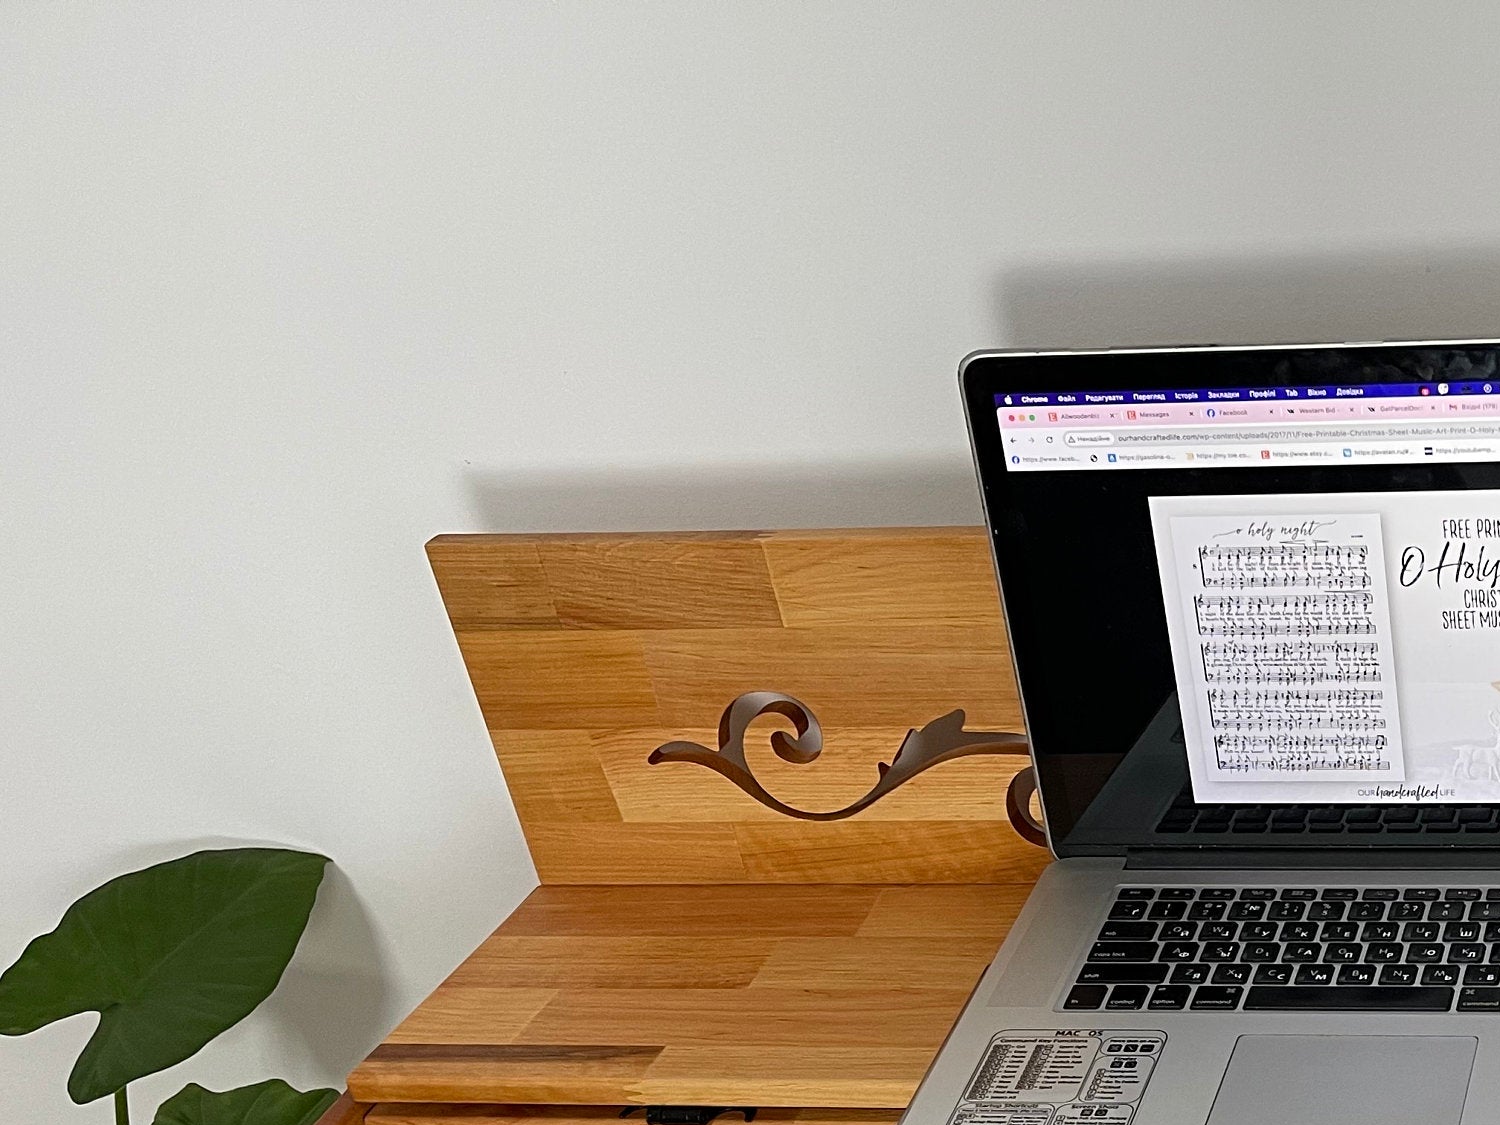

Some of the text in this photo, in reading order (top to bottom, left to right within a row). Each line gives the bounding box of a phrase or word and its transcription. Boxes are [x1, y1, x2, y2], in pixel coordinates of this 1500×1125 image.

[1085, 394, 1123, 403] Редагувати
[1133, 393, 1166, 402] Перегляд
[1175, 392, 1198, 400] Історія
[1208, 391, 1239, 399] Закладки
[1249, 390, 1275, 399] Профілі
[1286, 389, 1298, 397] Tab
[1336, 388, 1363, 396] Довідка
[1247, 521, 1276, 541] holy
[1280, 520, 1332, 540] night
[1442, 518, 1471, 539] FREE
[1400, 545, 1425, 588] O
[1441, 609, 1476, 630] SHEET
[1357, 783, 1456, 802] OUR handcrafted LIFE
